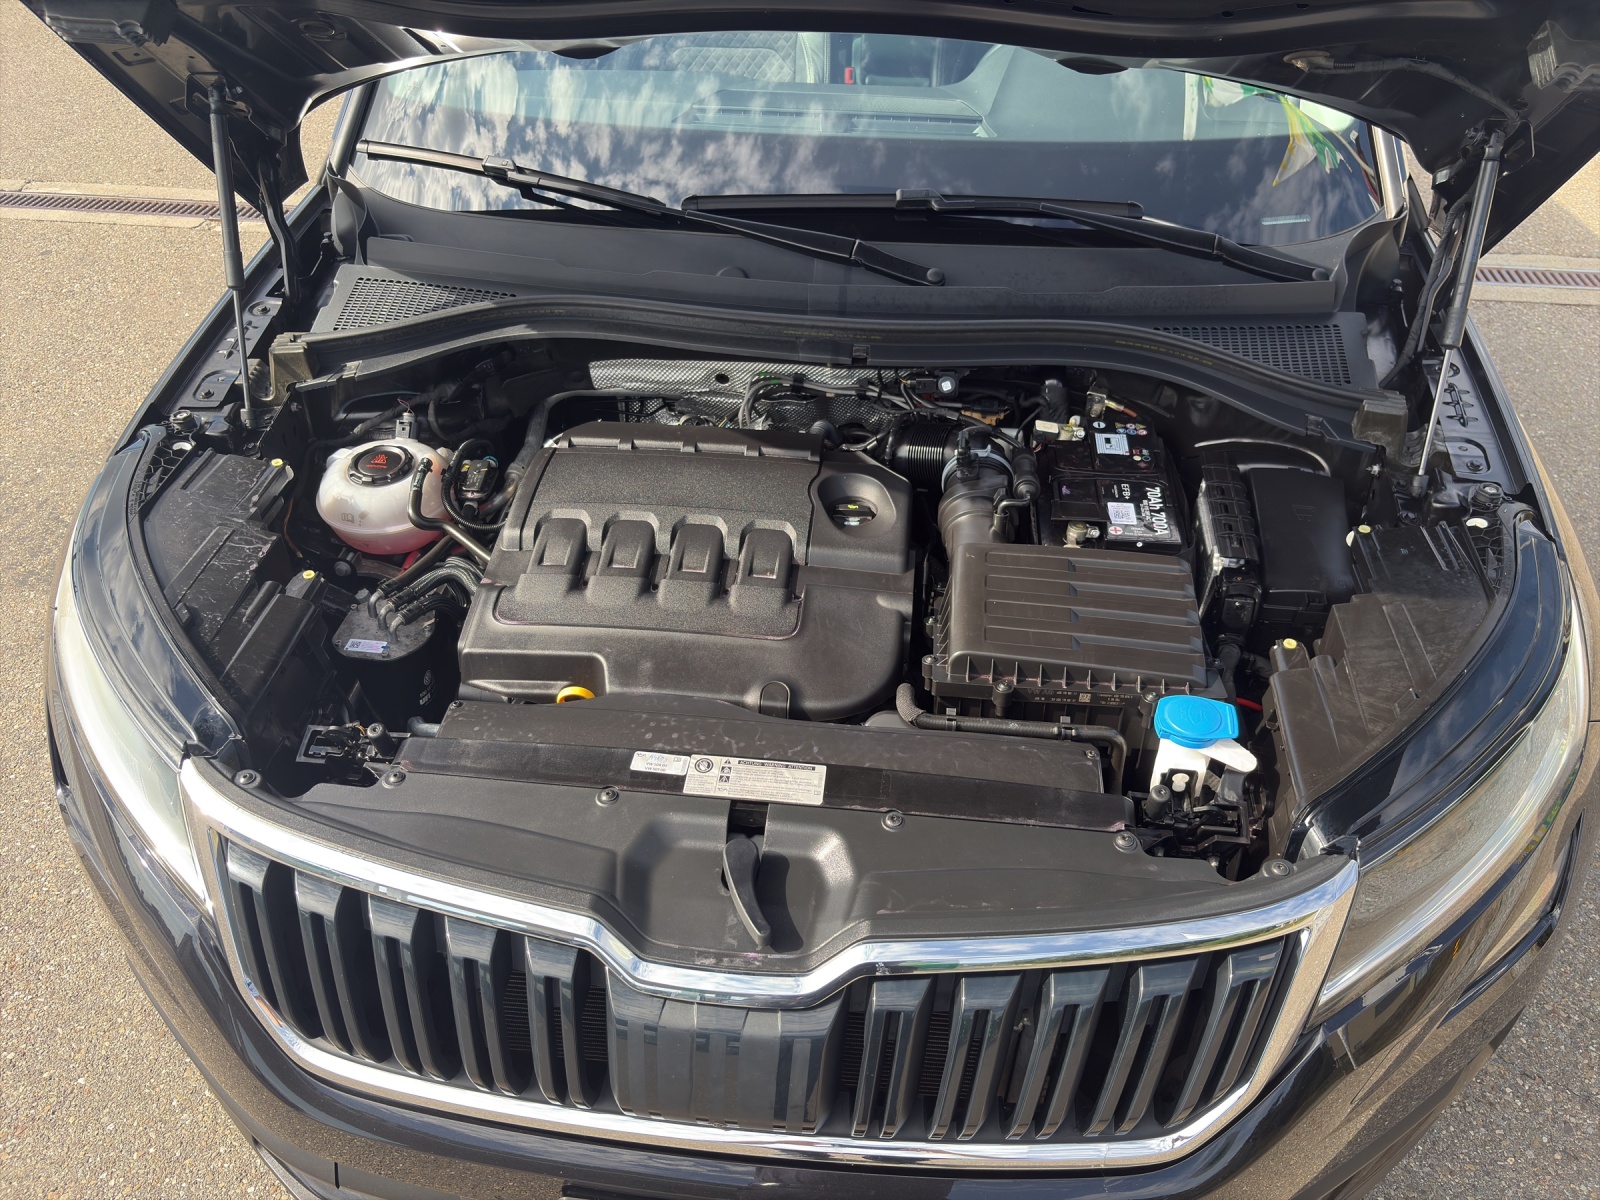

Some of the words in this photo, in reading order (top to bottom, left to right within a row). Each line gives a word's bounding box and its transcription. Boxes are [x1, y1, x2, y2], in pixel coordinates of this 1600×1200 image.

[1121, 484, 1130, 500] EFB+
[1145, 487, 1163, 510] 70Ah
[1151, 512, 1169, 535] 700A
